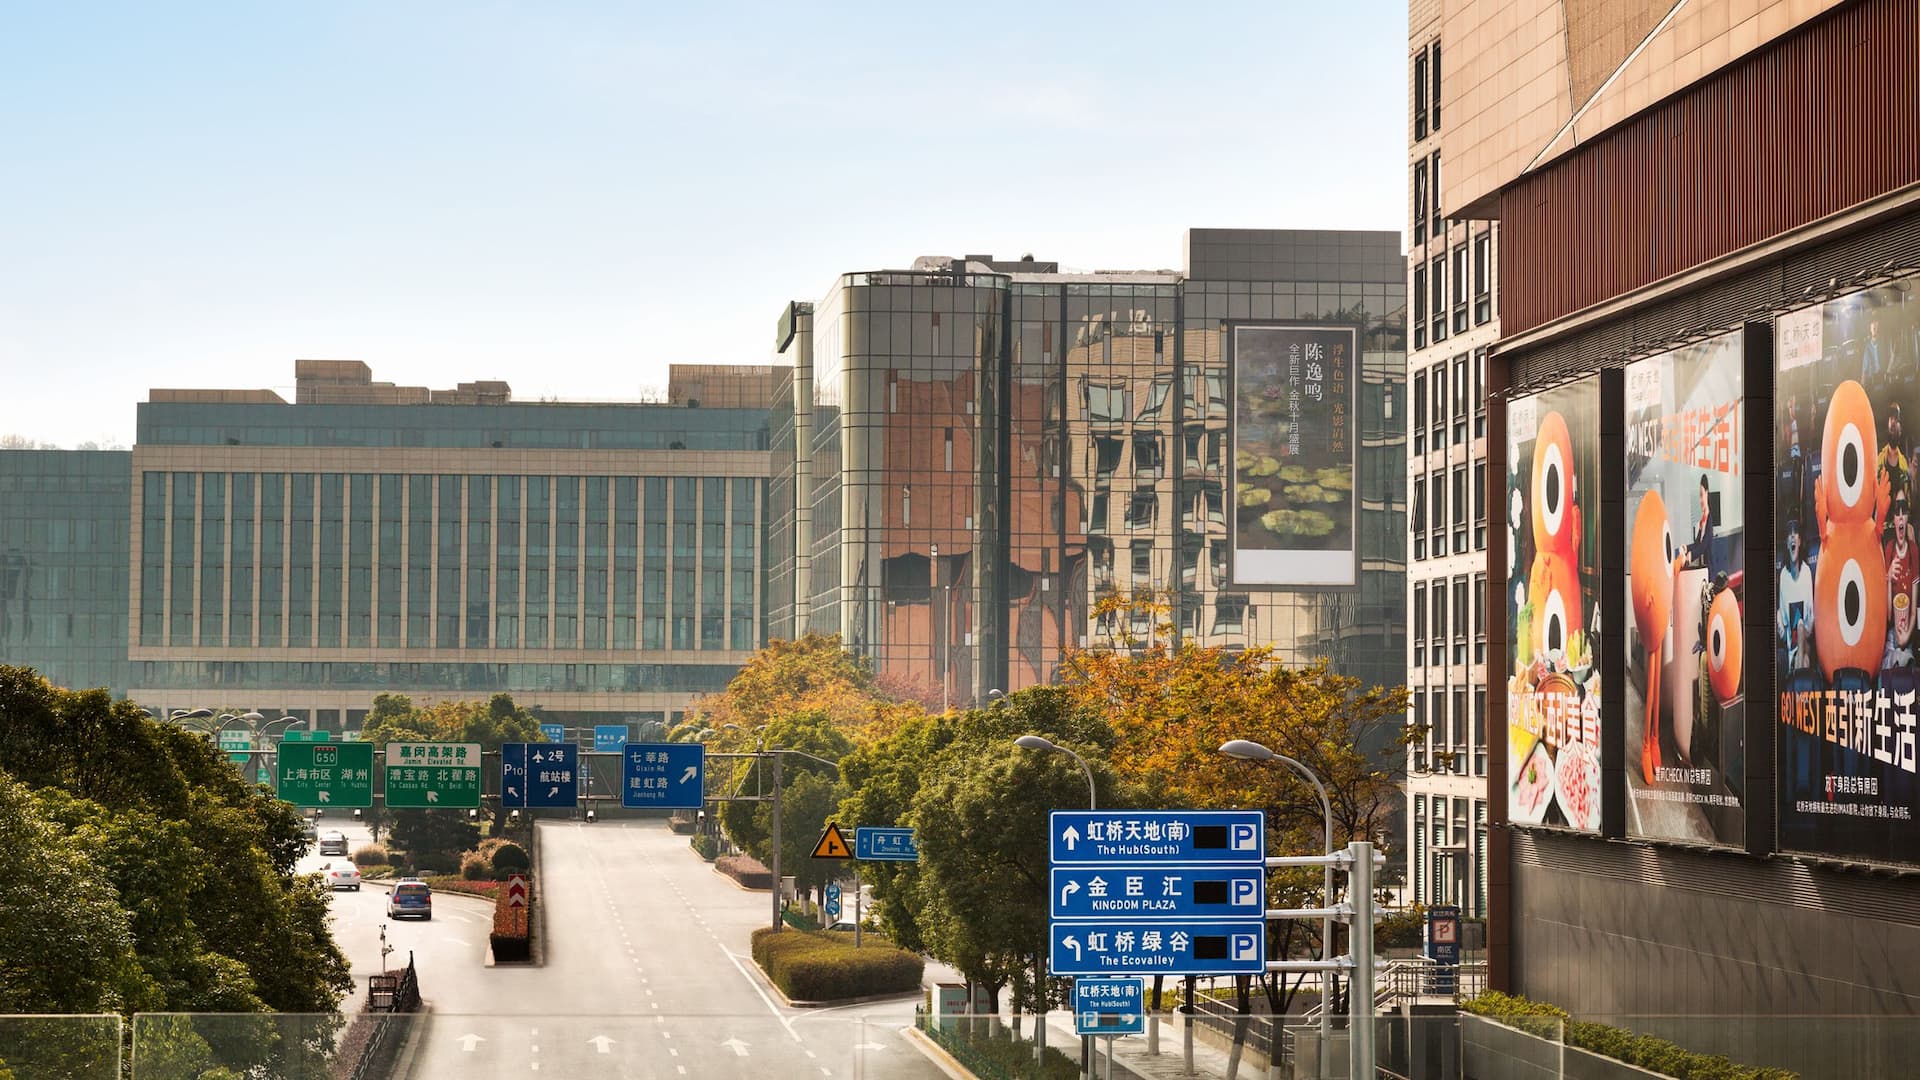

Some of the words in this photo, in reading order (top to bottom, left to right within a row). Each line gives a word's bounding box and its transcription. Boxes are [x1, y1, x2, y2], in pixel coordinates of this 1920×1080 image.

[1289, 344, 1300, 387] 全新巨作
[1305, 342, 1323, 401] 陈逸鸣
[1638, 419, 1657, 457] WEST
[1782, 691, 1794, 726] GO!
[1796, 691, 1821, 736] WEST
[1825, 688, 1916, 773] 西引新生活
[316, 753, 335, 763] G50
[548, 750, 565, 762] 2号
[630, 752, 669, 764] 七莘路
[283, 768, 331, 780] 上海市区
[341, 769, 368, 780] 湖州
[503, 764, 523, 776] P10
[540, 771, 571, 783] 航站楼
[630, 777, 668, 789] 建虹路
[1086, 820, 1190, 841] 虹桥天地(南)
[1235, 826, 1253, 848] P
[1097, 845, 1116, 855] The
[1118, 844, 1180, 856] Hub(South)
[1088, 876, 1182, 897] 金臣汇
[1235, 881, 1253, 904] P
[1092, 900, 1139, 910] KINGDOM
[1142, 900, 1176, 910] PLAZA
[1087, 931, 1189, 952] 虹桥绿谷
[1235, 936, 1253, 959] P
[1100, 956, 1120, 966] The
[1122, 955, 1175, 967] Ecovalley
[1080, 984, 1139, 998] 虹桥天地(南)
[1089, 1000, 1099, 1008] The
